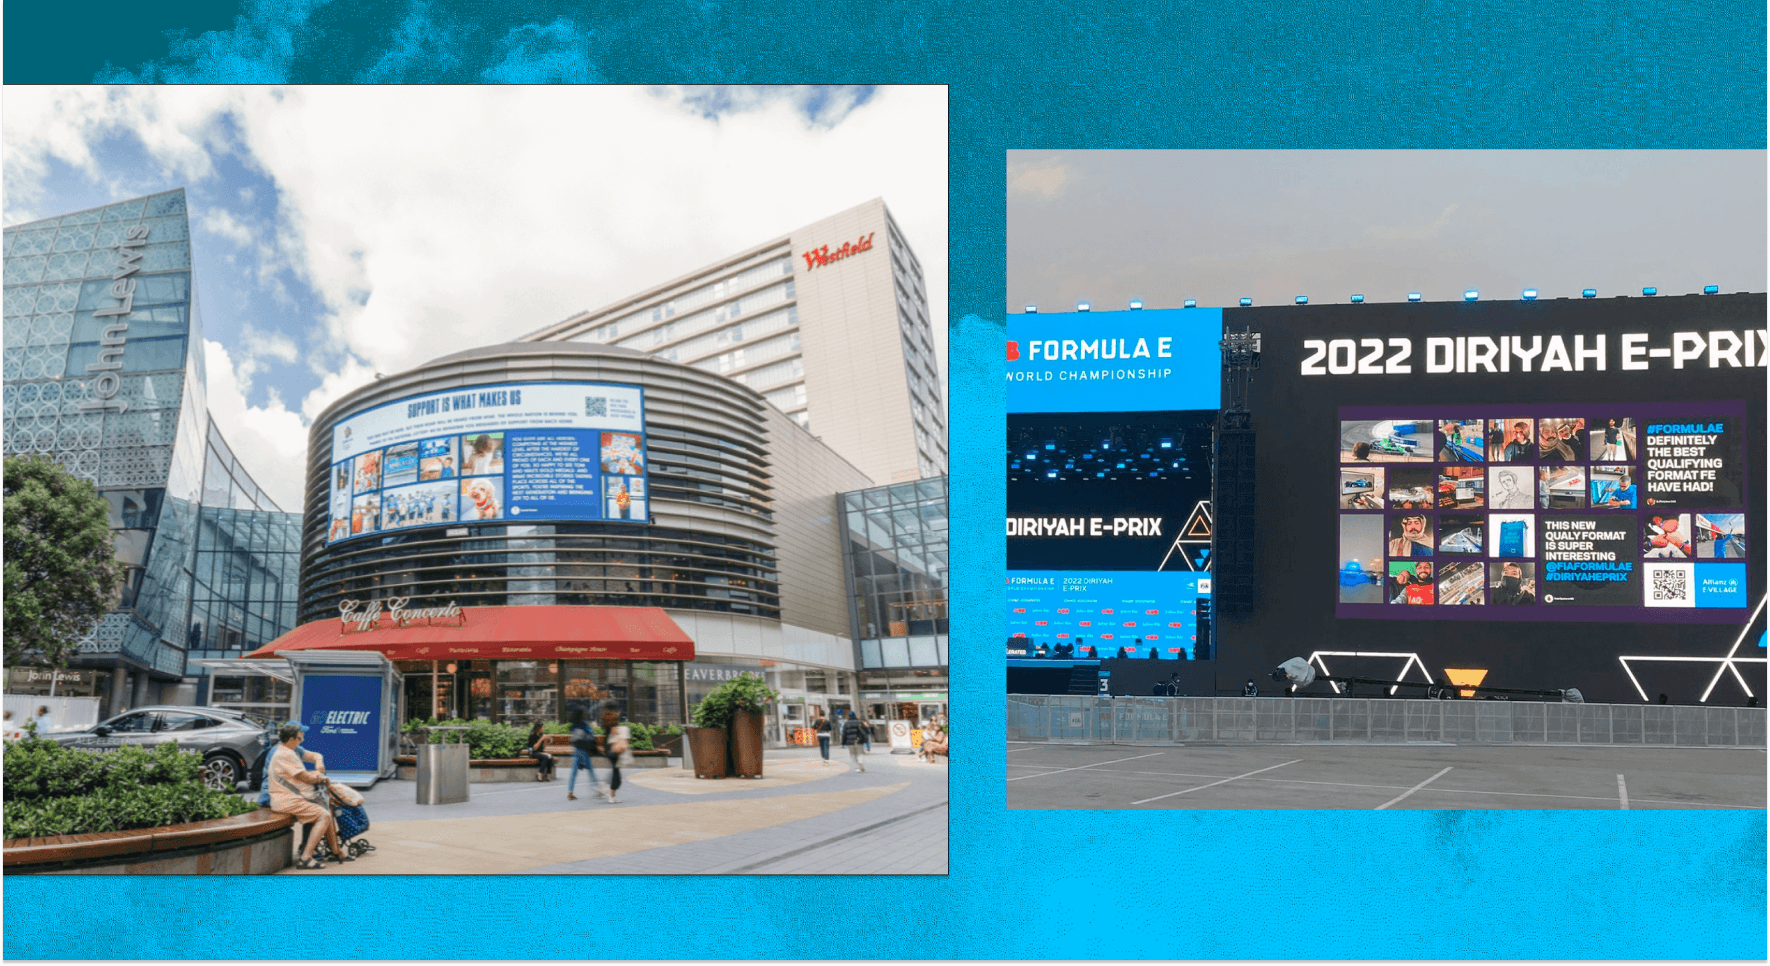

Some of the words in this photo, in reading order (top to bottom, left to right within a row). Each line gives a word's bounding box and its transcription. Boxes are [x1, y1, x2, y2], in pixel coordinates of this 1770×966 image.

[802, 232, 875, 272] Westfield
[92, 224, 150, 318] Lewis
[1029, 338, 1150, 360] FORMULA
[1158, 336, 1172, 358] E
[1300, 338, 1412, 375] 2022
[1426, 333, 1606, 373] DIRIYAH
[79, 323, 128, 414] John
[1059, 368, 1172, 380] CHAMPIONSHIP
[408, 398, 440, 418] SUPPORT
[442, 396, 450, 412] IS
[452, 393, 476, 411] WHAT
[478, 390, 507, 408] MAKES
[510, 390, 522, 406] US
[1646, 424, 1724, 434] #FORMULAE
[1647, 435, 1717, 445] DEFINITELY
[1647, 447, 1671, 457] THE
[1674, 447, 1706, 457] BEST
[1648, 458, 1722, 470] QUALIFYING
[1648, 470, 1698, 480] FORMAT
[1700, 470, 1716, 480] FE
[1648, 482, 1681, 492] HAVE
[1683, 482, 1713, 492] HAD!
[1006, 518, 1084, 536] DIRIYAH
[1090, 518, 1162, 536] E-PRIX
[1545, 521, 1570, 530] THIS
[1571, 521, 1596, 530] NEW
[1545, 532, 1580, 542] QUALY
[1582, 532, 1626, 540] FORMAT
[1546, 542, 1556, 550] IS
[1558, 542, 1594, 550] SUPER
[1546, 552, 1616, 561] INTERESTING
[1546, 562, 1633, 572] @FIAFORMULAE
[1546, 573, 1628, 581] #DIRIYAHEPRIX
[388, 596, 462, 623] Concerto
[1100, 679, 1108, 691] 3
[325, 710, 371, 724] ELECTRIC
